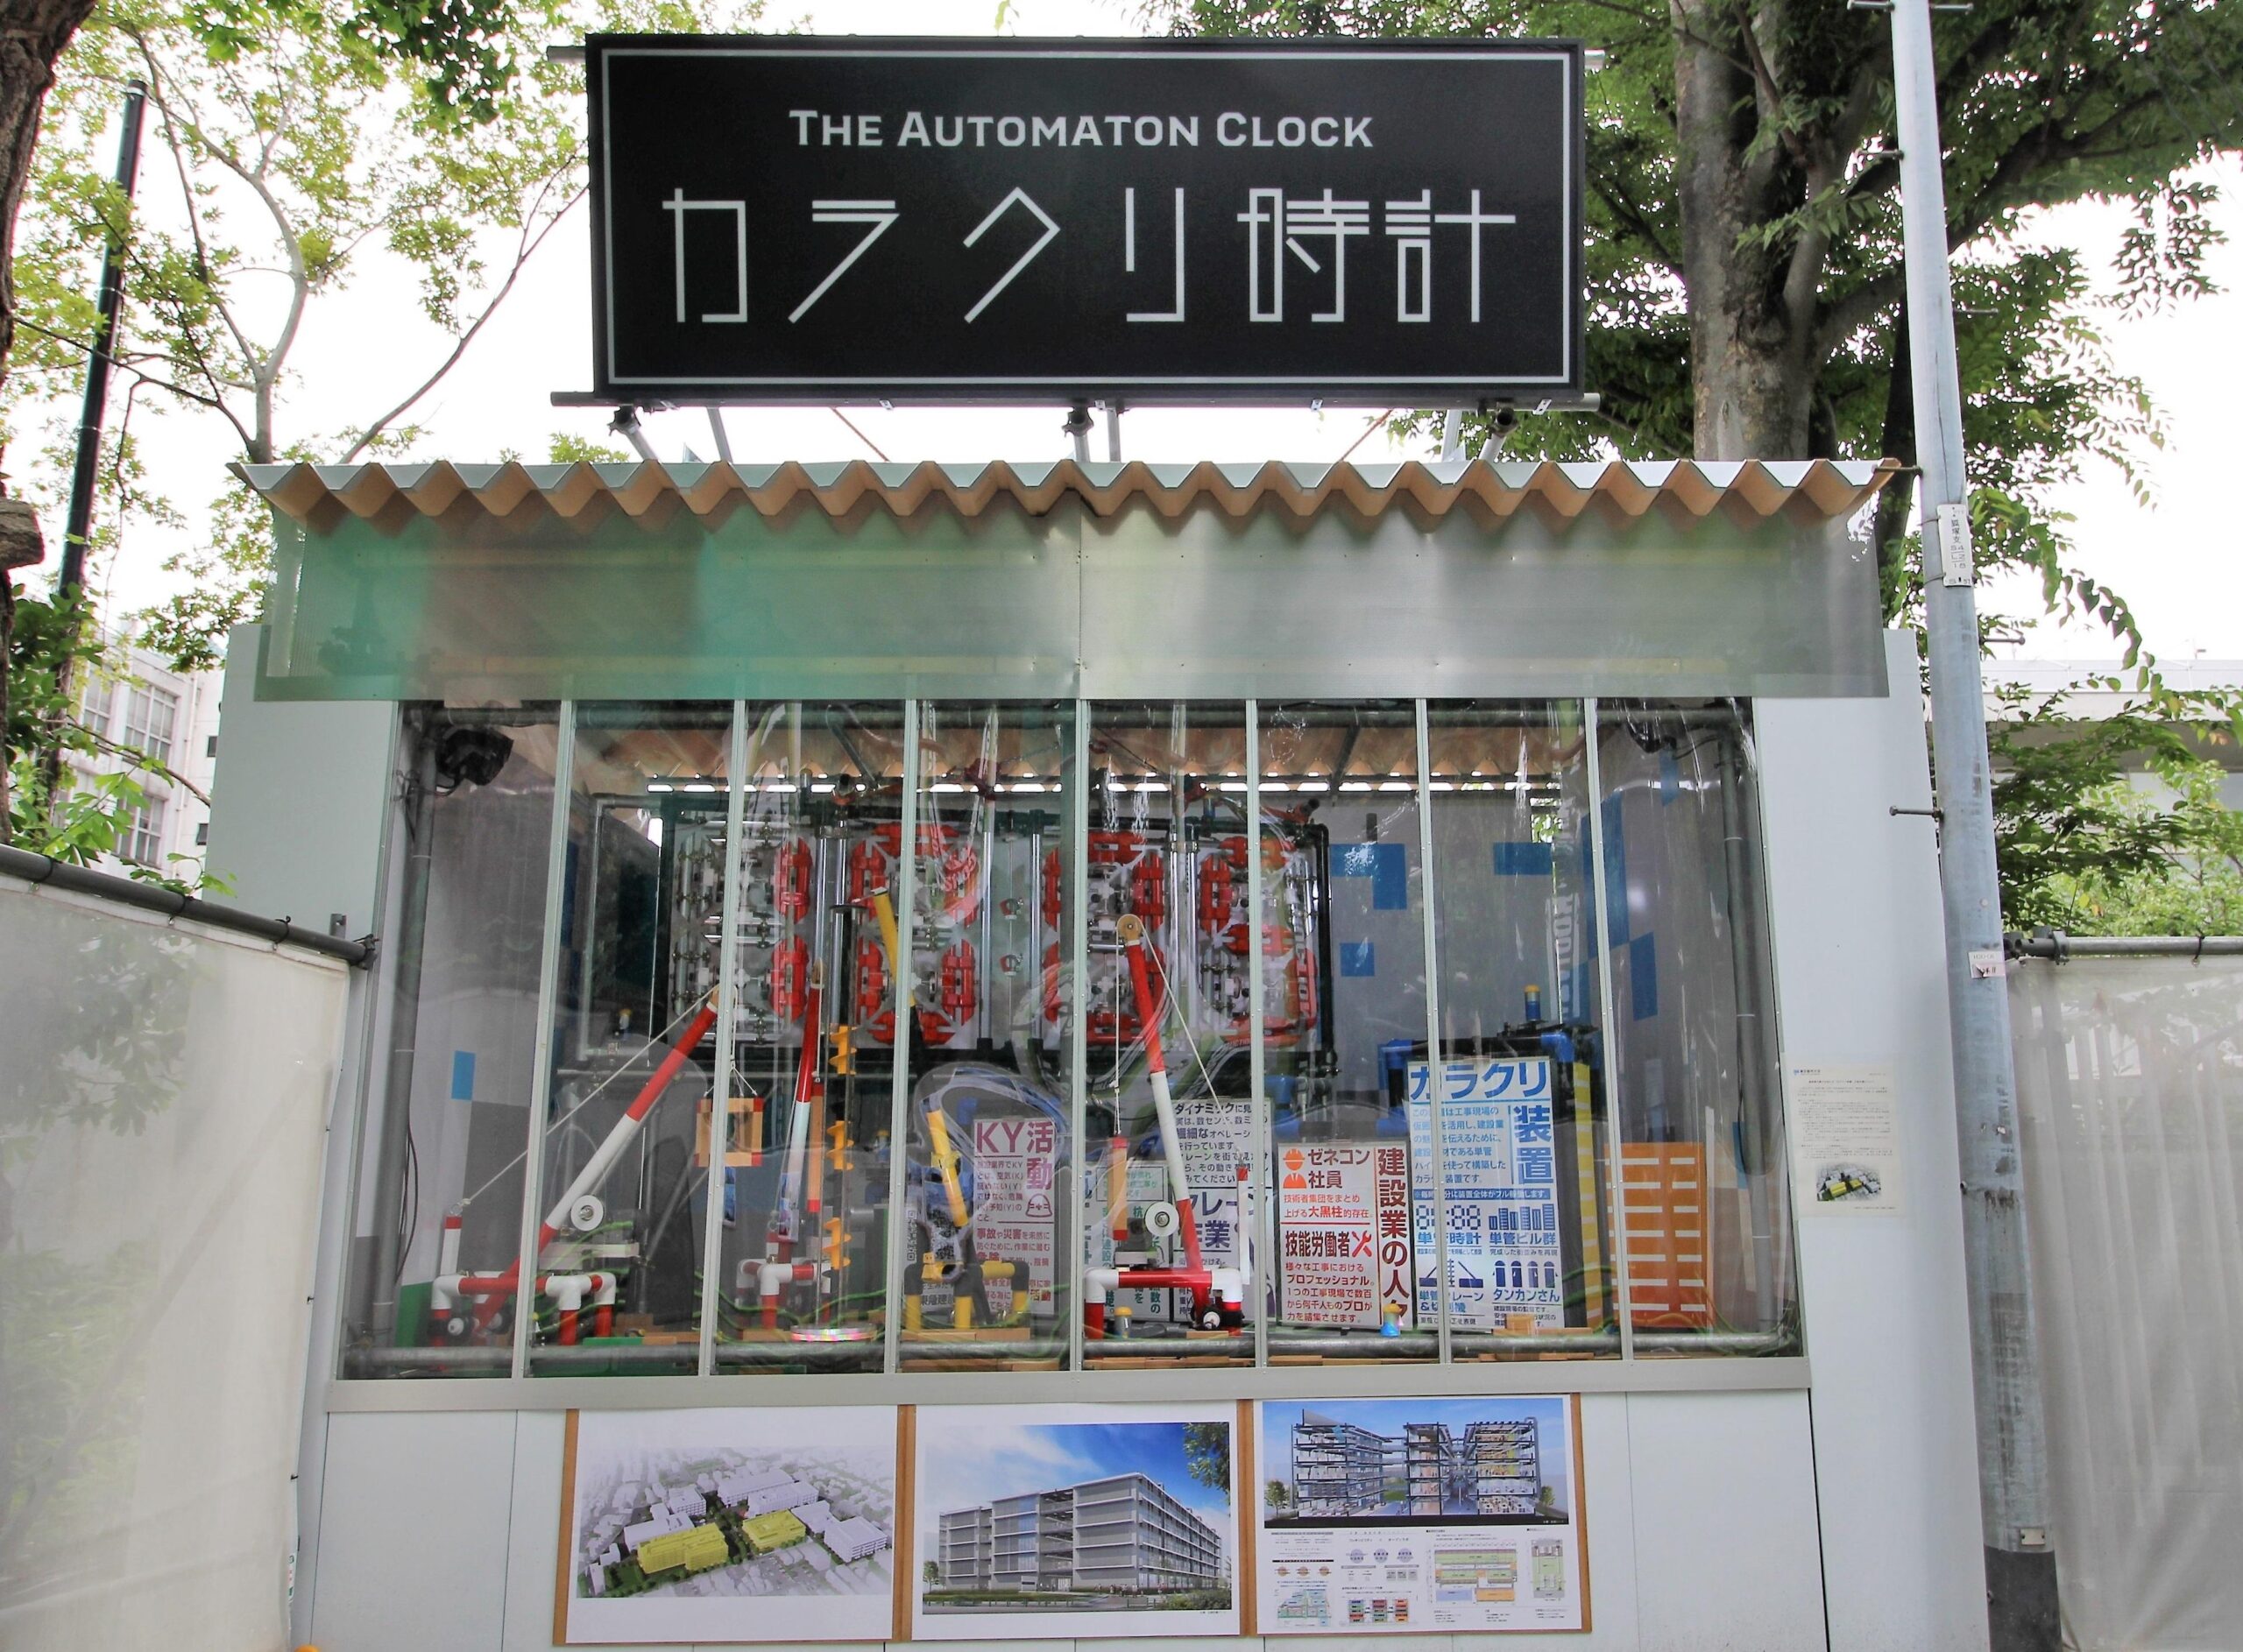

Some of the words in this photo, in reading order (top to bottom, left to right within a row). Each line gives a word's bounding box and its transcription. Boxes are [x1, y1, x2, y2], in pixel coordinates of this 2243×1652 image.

[1410, 1062, 1547, 1100] カラクリ
[1413, 1106, 1499, 1117] このは工事現場の
[1308, 1148, 1370, 1166] ゼネコン
[1308, 1170, 1342, 1189] 社員
[1415, 1175, 1483, 1183] カラ装置です。
[1285, 1230, 1350, 1257] 技能労働者
[1418, 1232, 1482, 1245] 単時計
[1419, 1290, 1484, 1302] 単管レーン
